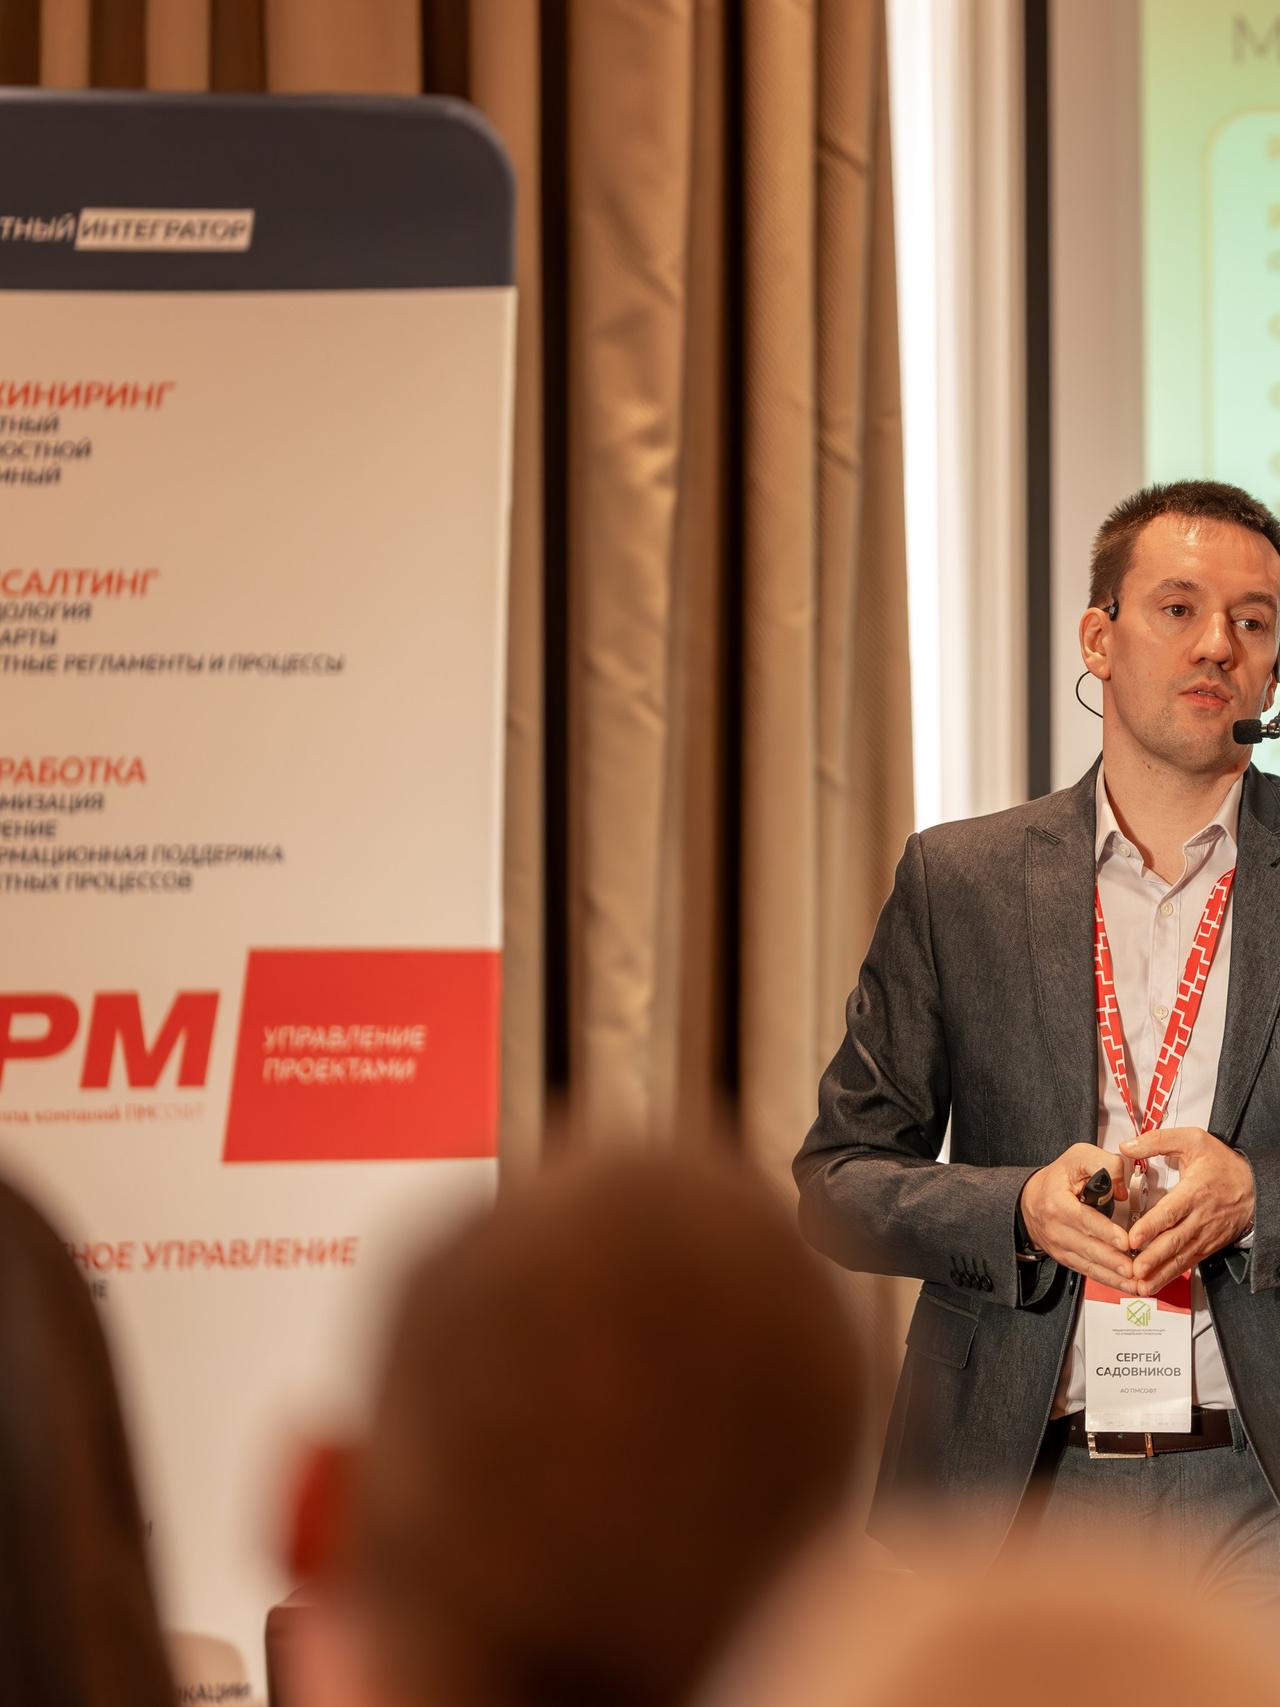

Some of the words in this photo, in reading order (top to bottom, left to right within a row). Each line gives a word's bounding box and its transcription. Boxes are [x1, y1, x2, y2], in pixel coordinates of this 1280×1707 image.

[80, 216, 248, 242] ИНТЕГРАТОР
[0, 379, 177, 411] ИНИРИНГ
[63, 652, 204, 676] РЕГЛАМЕНТЫ
[208, 653, 225, 672] И
[228, 652, 346, 676] ПРОЦЕССЫ
[152, 844, 285, 869] ПОДДЕРЖКА
[0, 871, 60, 894] ТНЫХ
[65, 871, 195, 896] ПРОЦЕССОВ
[263, 1024, 426, 1053] УПРАВЛЕНИЕ
[262, 1056, 418, 1084] ПРОЕКТАМИ
[142, 1236, 361, 1274] УПРАВЛЕНИЕ
[1116, 1351, 1161, 1363] СЕРГЕЙ
[1096, 1366, 1182, 1378] САДОВНИКОВ
